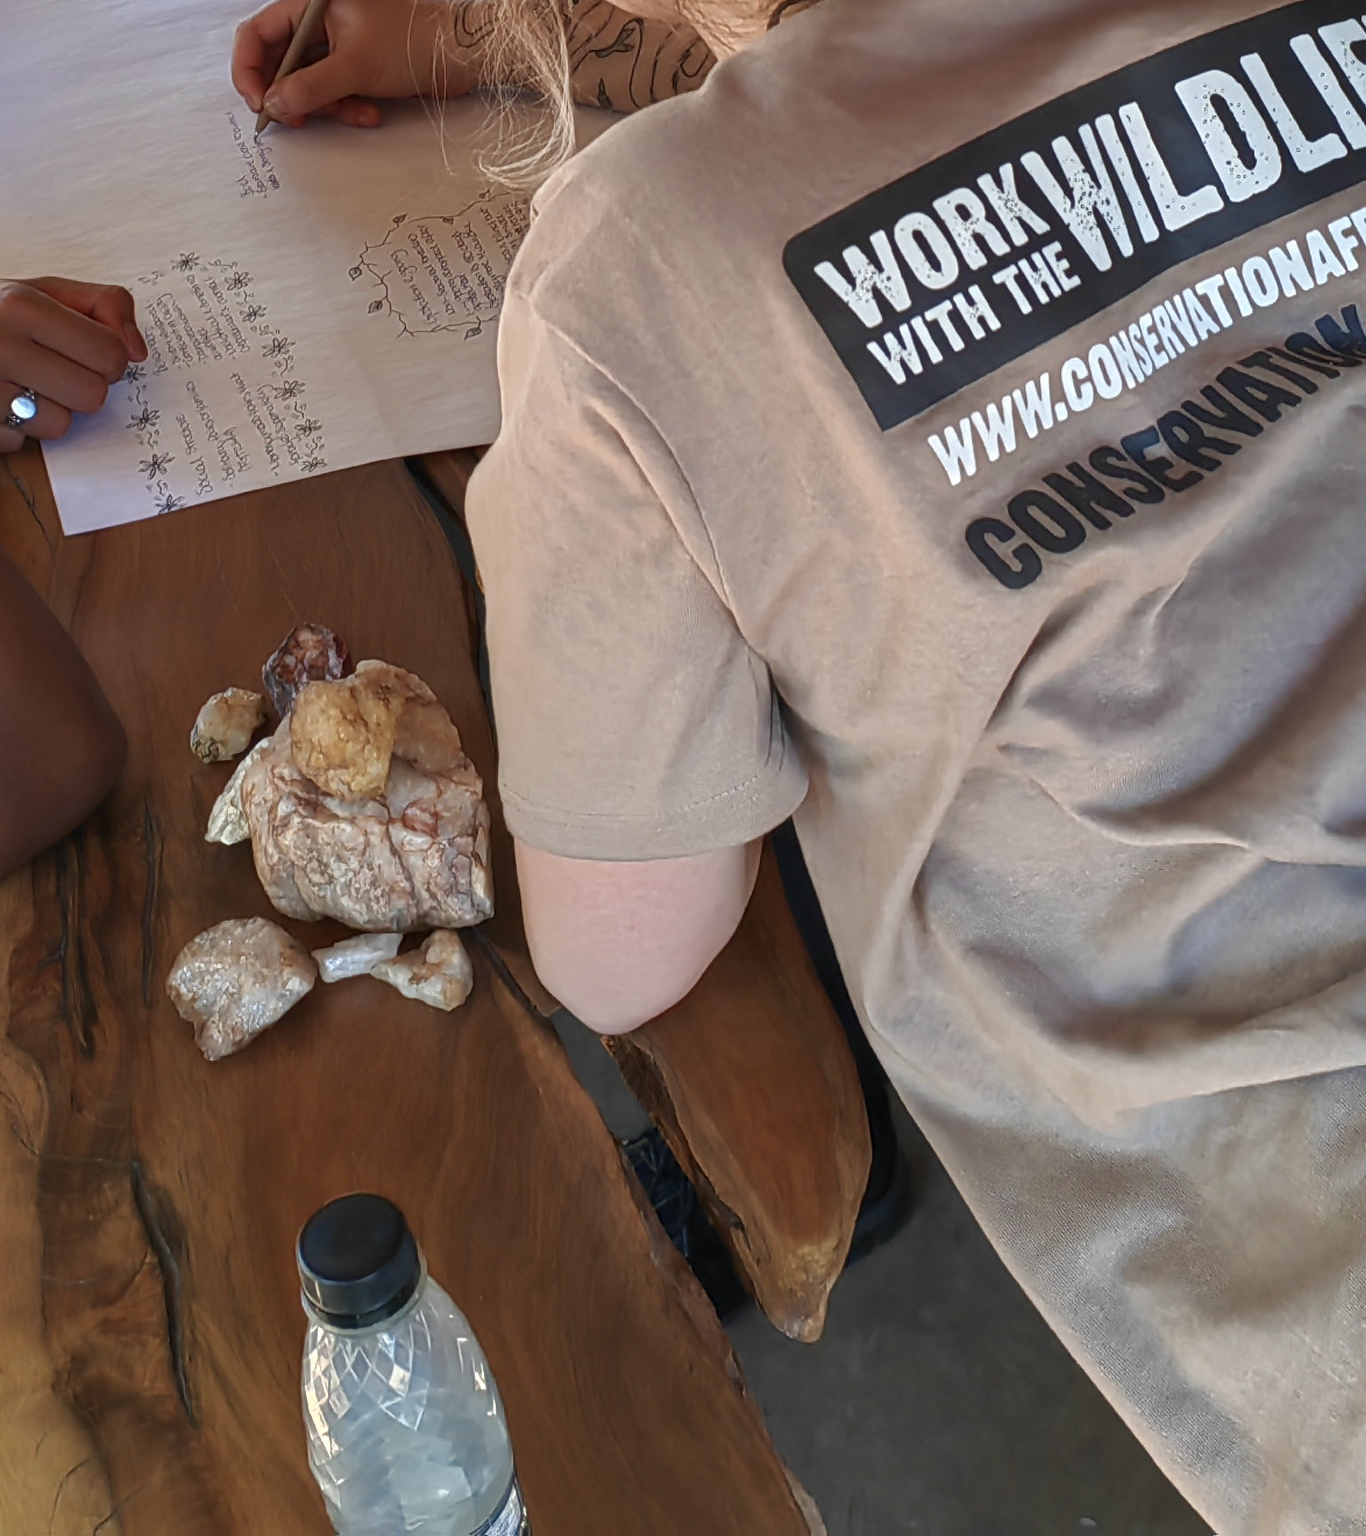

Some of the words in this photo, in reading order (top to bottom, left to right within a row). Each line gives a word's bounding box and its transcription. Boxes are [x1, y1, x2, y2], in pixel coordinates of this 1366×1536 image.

[814, 162, 1050, 329] WORK
[866, 272, 1002, 387] WITH
[1002, 239, 1082, 330] THE
